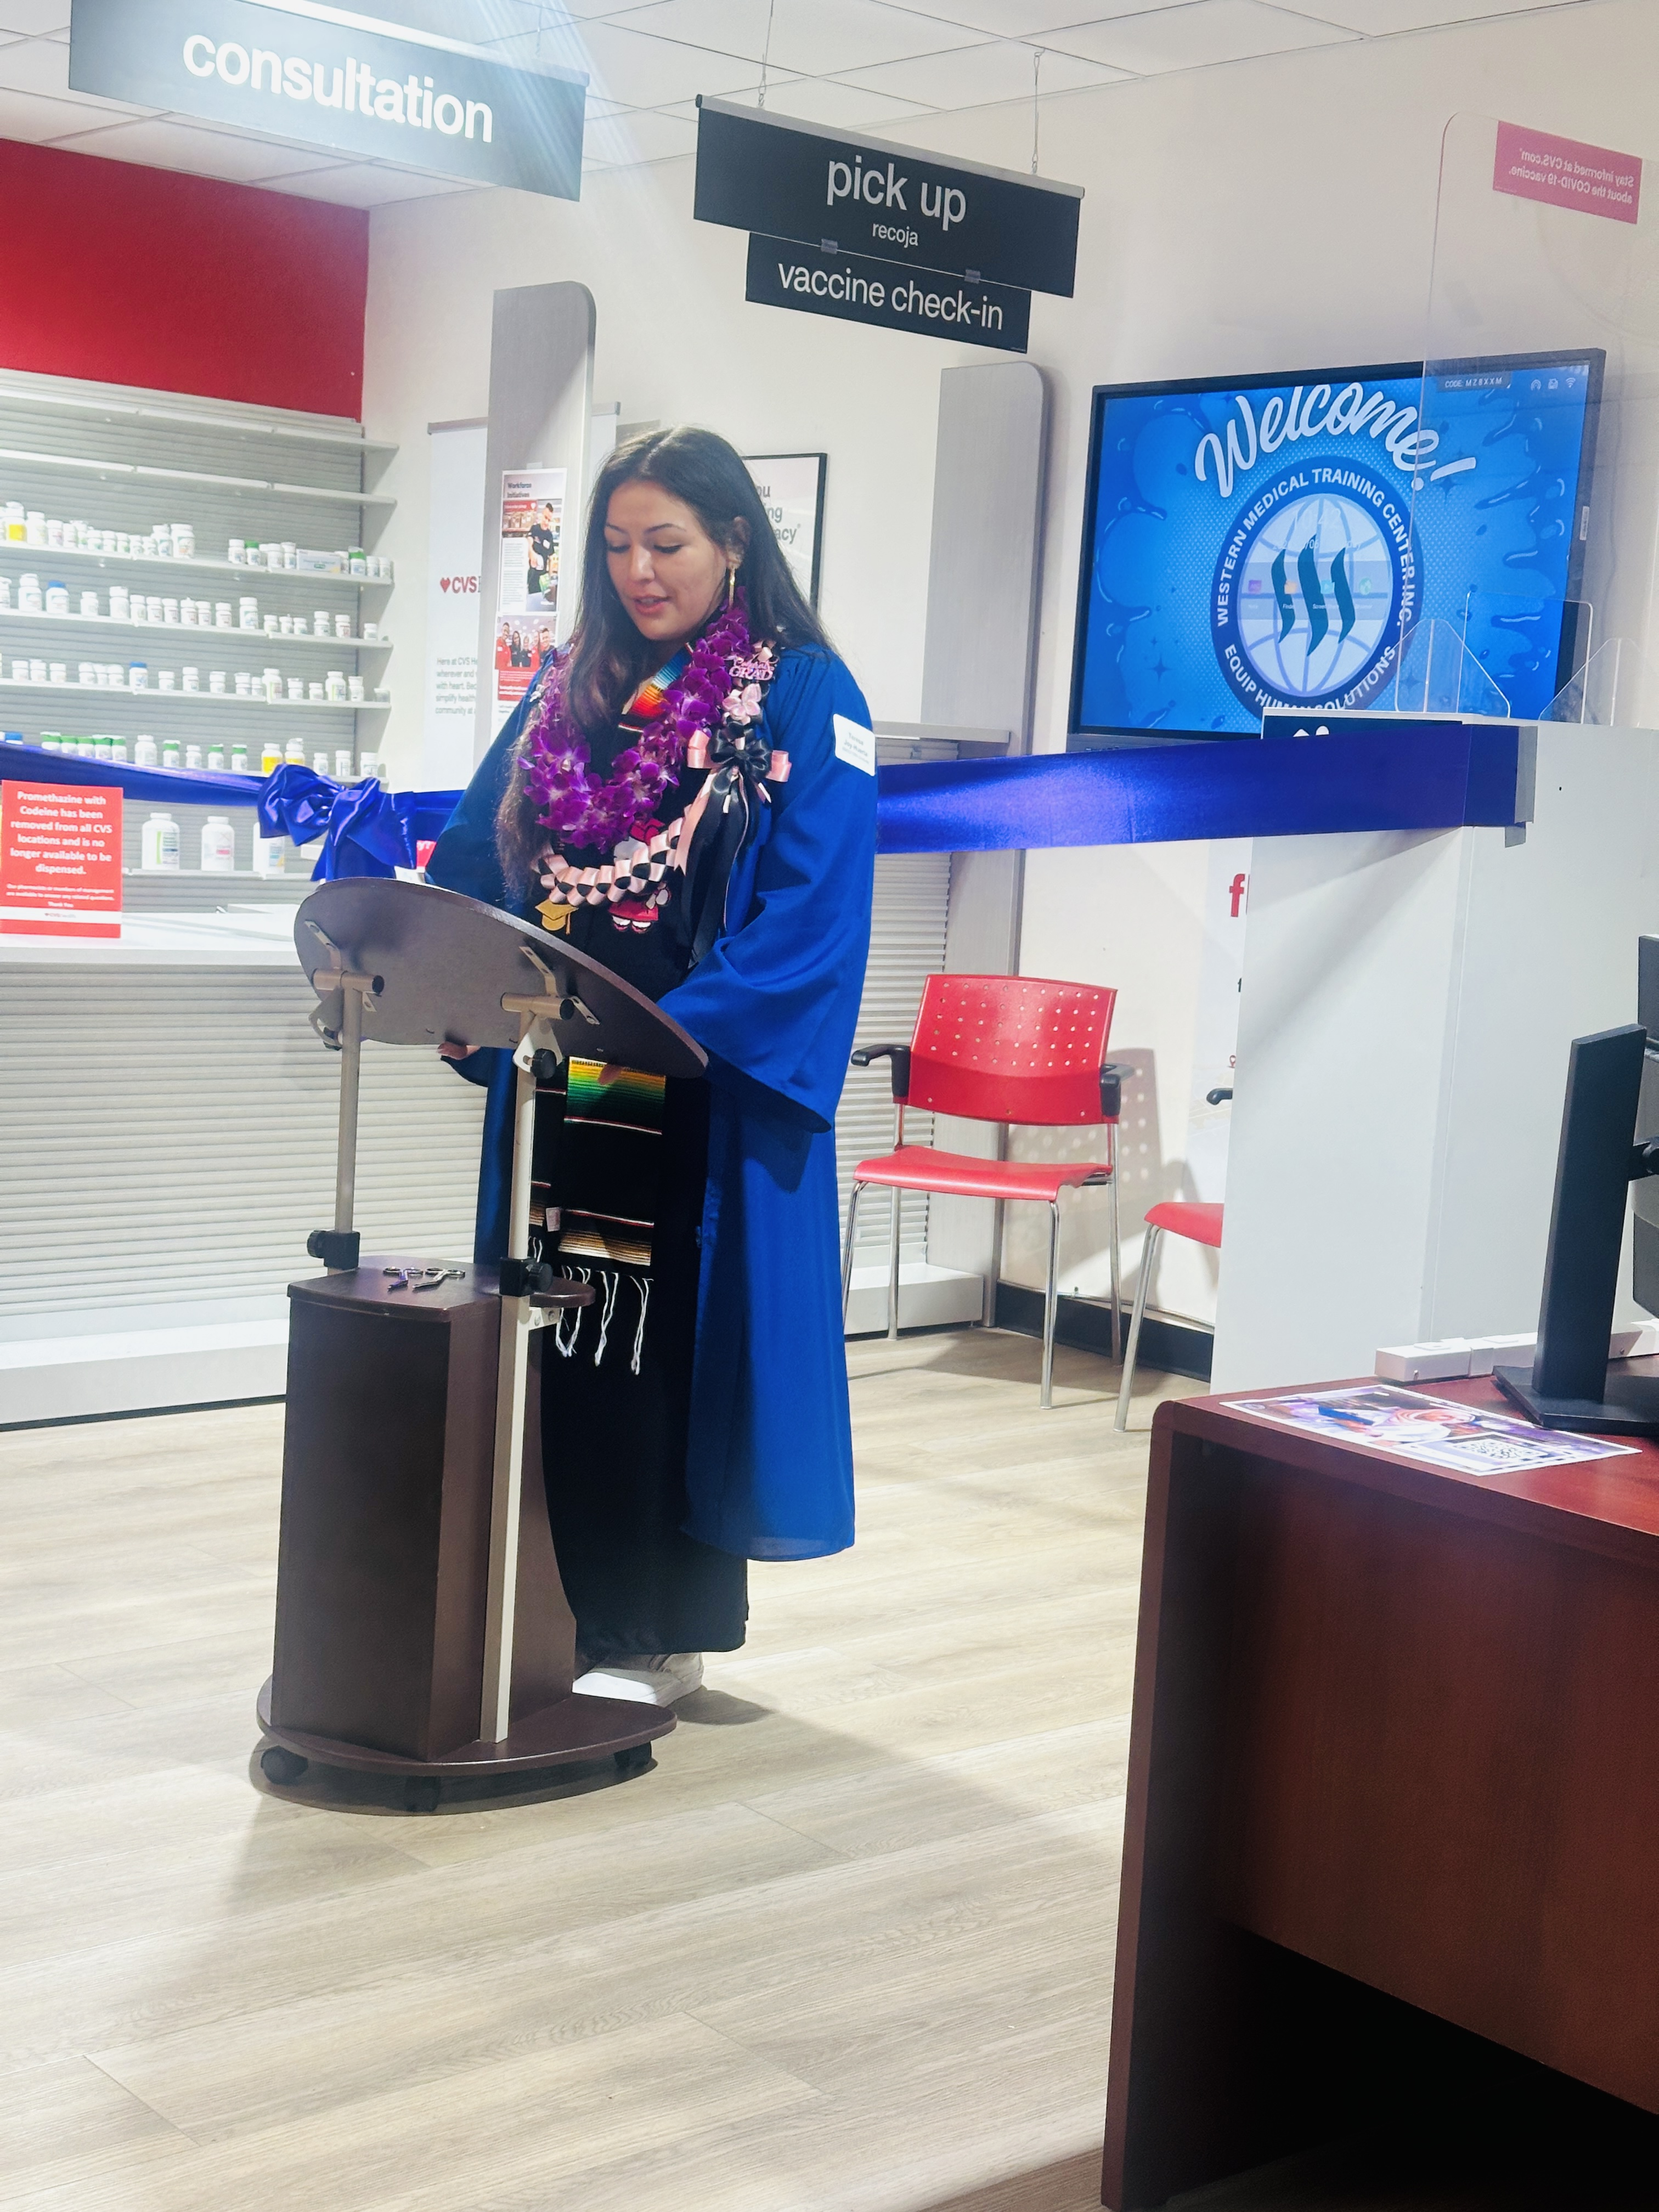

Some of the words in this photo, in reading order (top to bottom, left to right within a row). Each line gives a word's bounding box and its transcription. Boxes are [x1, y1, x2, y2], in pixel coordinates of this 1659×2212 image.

[183, 34, 493, 143] consultation
[827, 155, 907, 211] pick
[921, 182, 967, 230] up
[872, 222, 919, 248] recoja
[778, 263, 885, 308] vaccine
[891, 280, 1003, 331] check-in
[1194, 382, 1476, 498] Welcome!
[1217, 529, 1247, 627] WESTERN
[1243, 473, 1309, 531] MEDICAL
[1312, 467, 1385, 507] TRAINING
[1383, 503, 1415, 580] CENTER
[729, 666, 773, 681] GRAD
[1224, 644, 1256, 693] EQUIP
[1255, 689, 1312, 709] HUM
[17, 791, 82, 804] Promethazine
[84, 795, 106, 805] with
[19, 805, 59, 817] Codeine
[60, 808, 77, 818] has
[78, 809, 103, 819] been
[10, 821, 53, 831] removed
[55, 821, 78, 832] from
[80, 823, 92, 832] all
[93, 824, 112, 833] CVS
[17, 833, 60, 845] locations
[62, 837, 80, 847] and
[82, 837, 91, 847] is
[92, 839, 105, 848] no
[10, 847, 41, 859] longer
[42, 850, 85, 861] available
[87, 852, 98, 861] to
[99, 852, 112, 861] be
[35, 863, 87, 874] dispensed.
